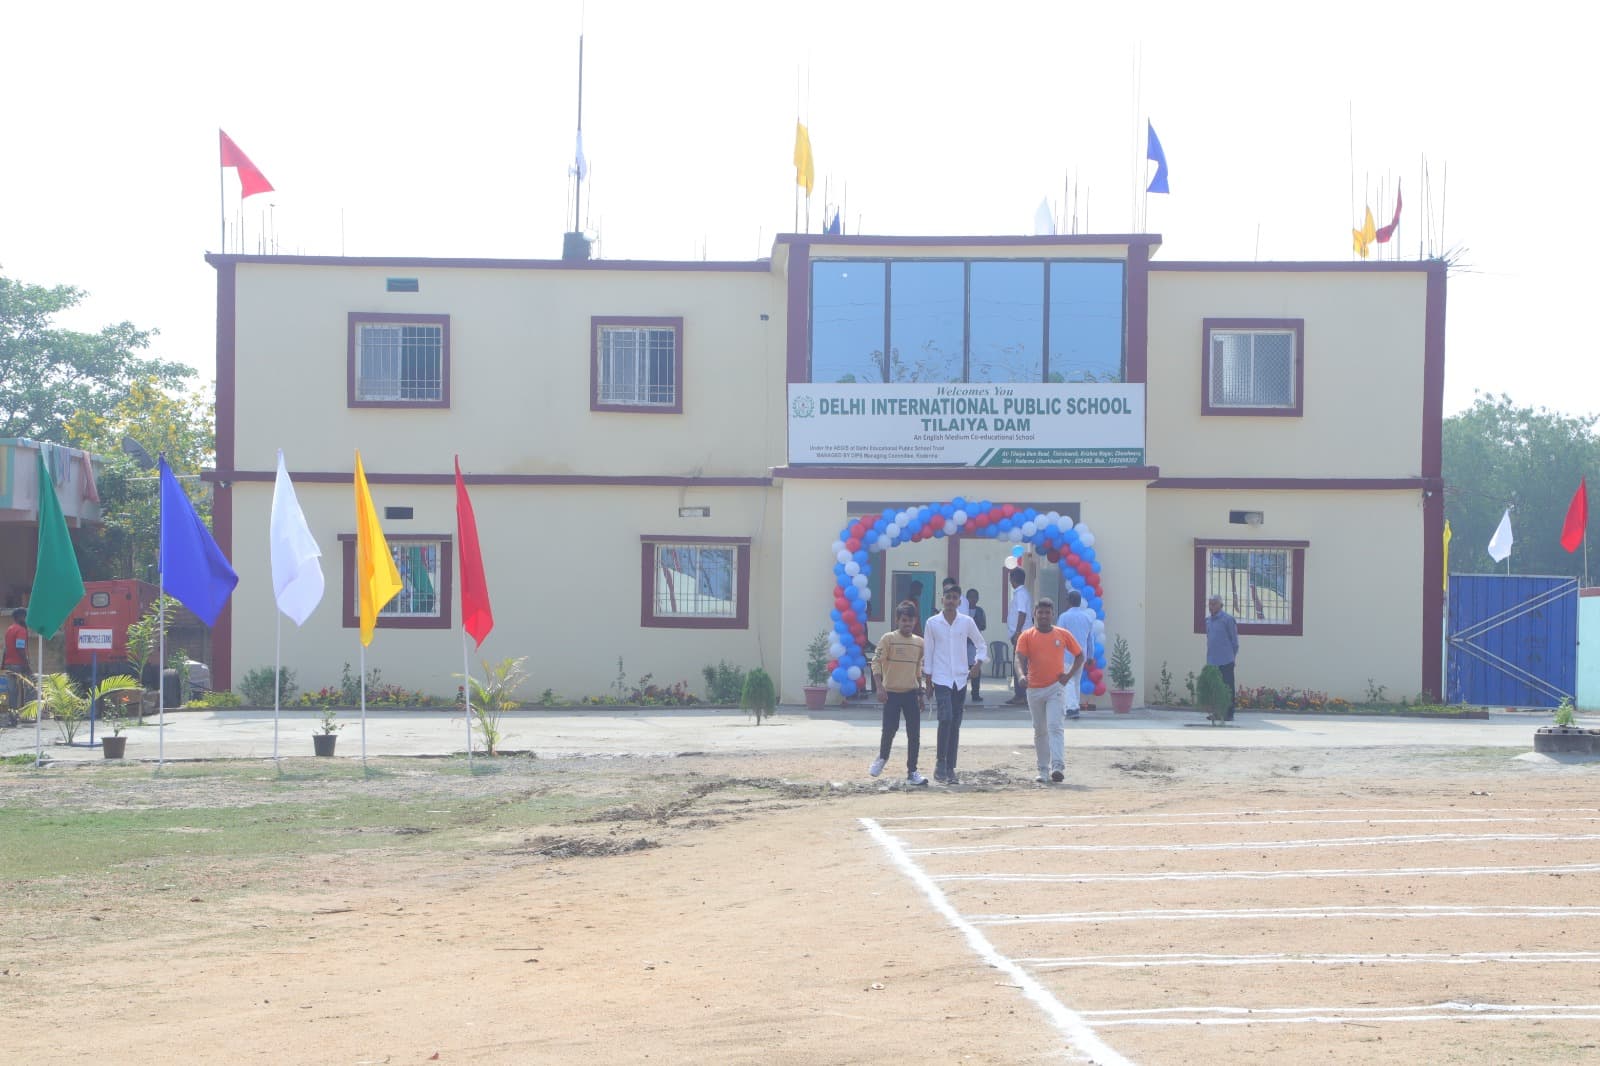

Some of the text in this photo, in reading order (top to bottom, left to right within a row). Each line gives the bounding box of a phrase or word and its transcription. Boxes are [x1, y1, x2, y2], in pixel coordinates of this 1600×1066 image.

[936, 387, 1014, 396] Welcomes You
[819, 397, 1132, 415] DELHI INTERNATIONAL PUBLIC SCHOOL
[921, 418, 1031, 431] TILAIYA DAM
[923, 434, 944, 442] English
[1016, 433, 1035, 441] School
